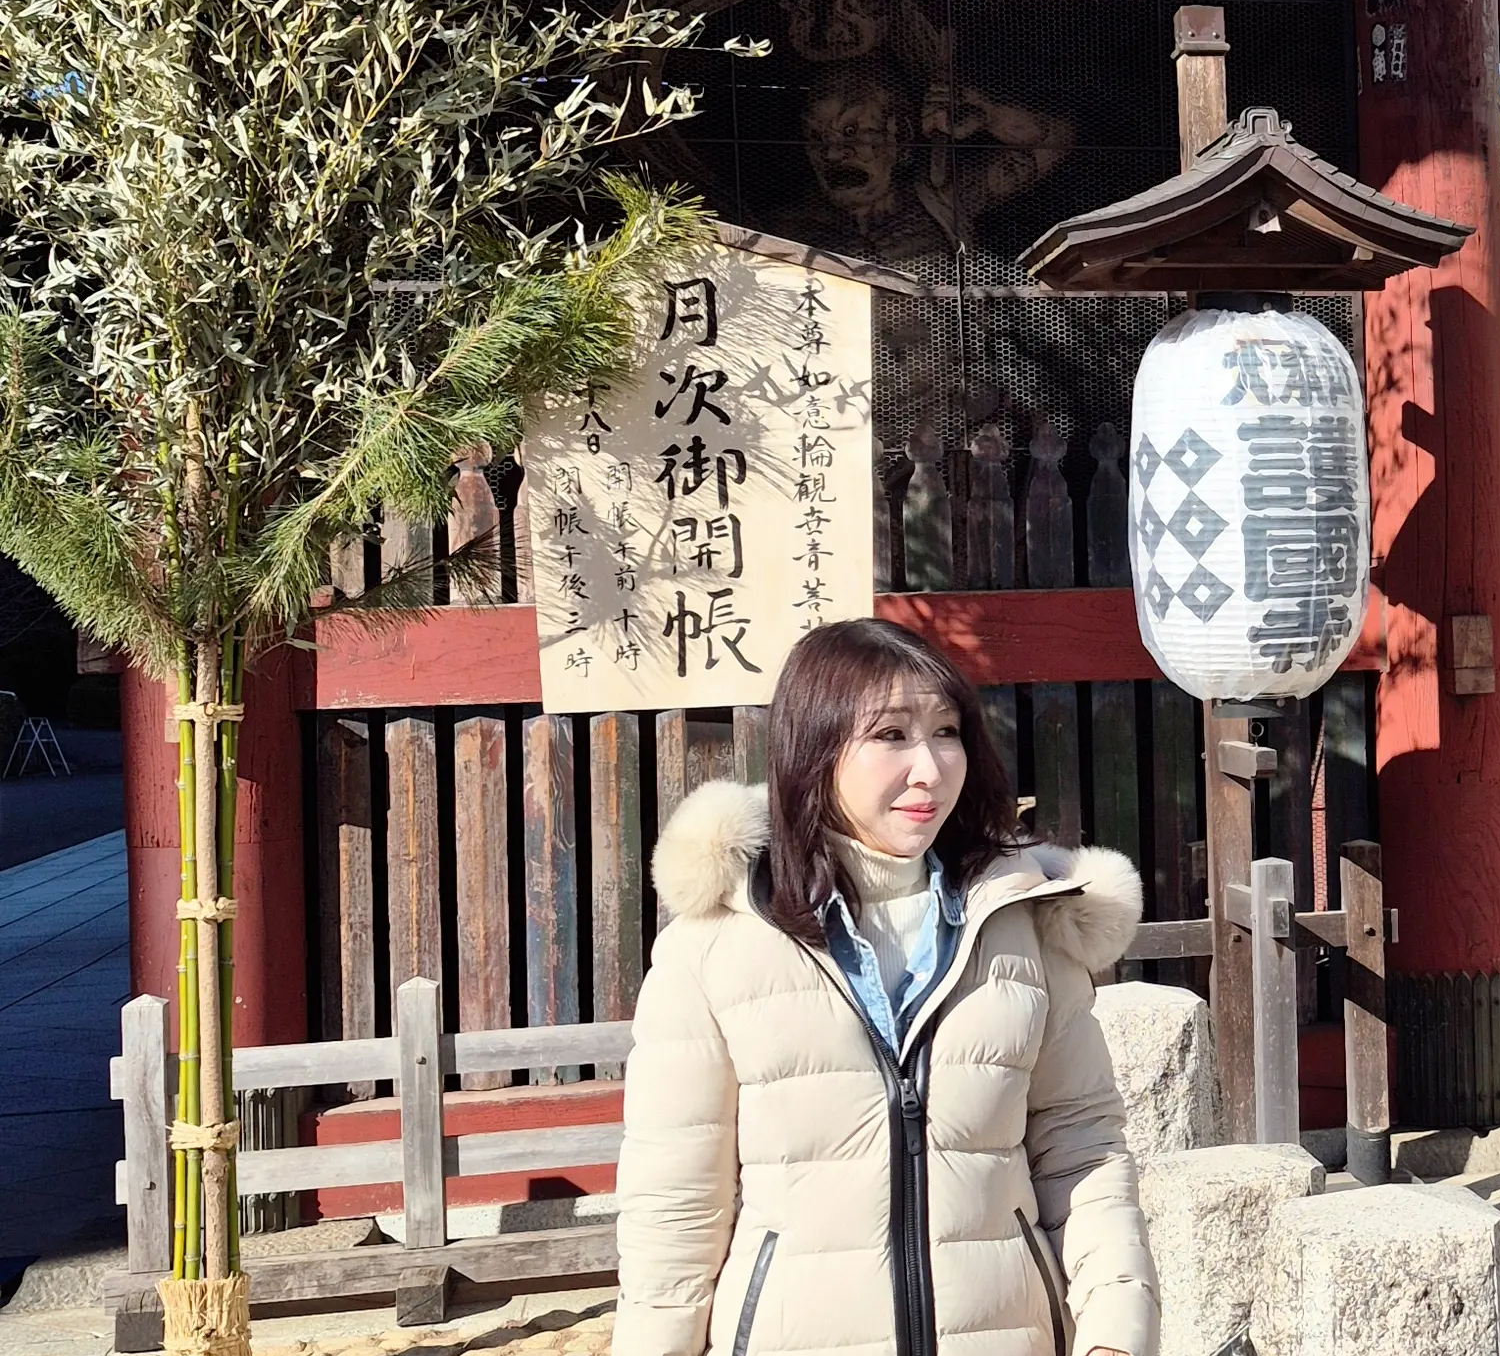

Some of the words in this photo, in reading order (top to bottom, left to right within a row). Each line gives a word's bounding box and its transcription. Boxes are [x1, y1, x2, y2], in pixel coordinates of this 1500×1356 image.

[572, 378, 613, 456] 十八日
[653, 278, 763, 677] 月次御開帳
[606, 461, 642, 672] 開帳午前十時
